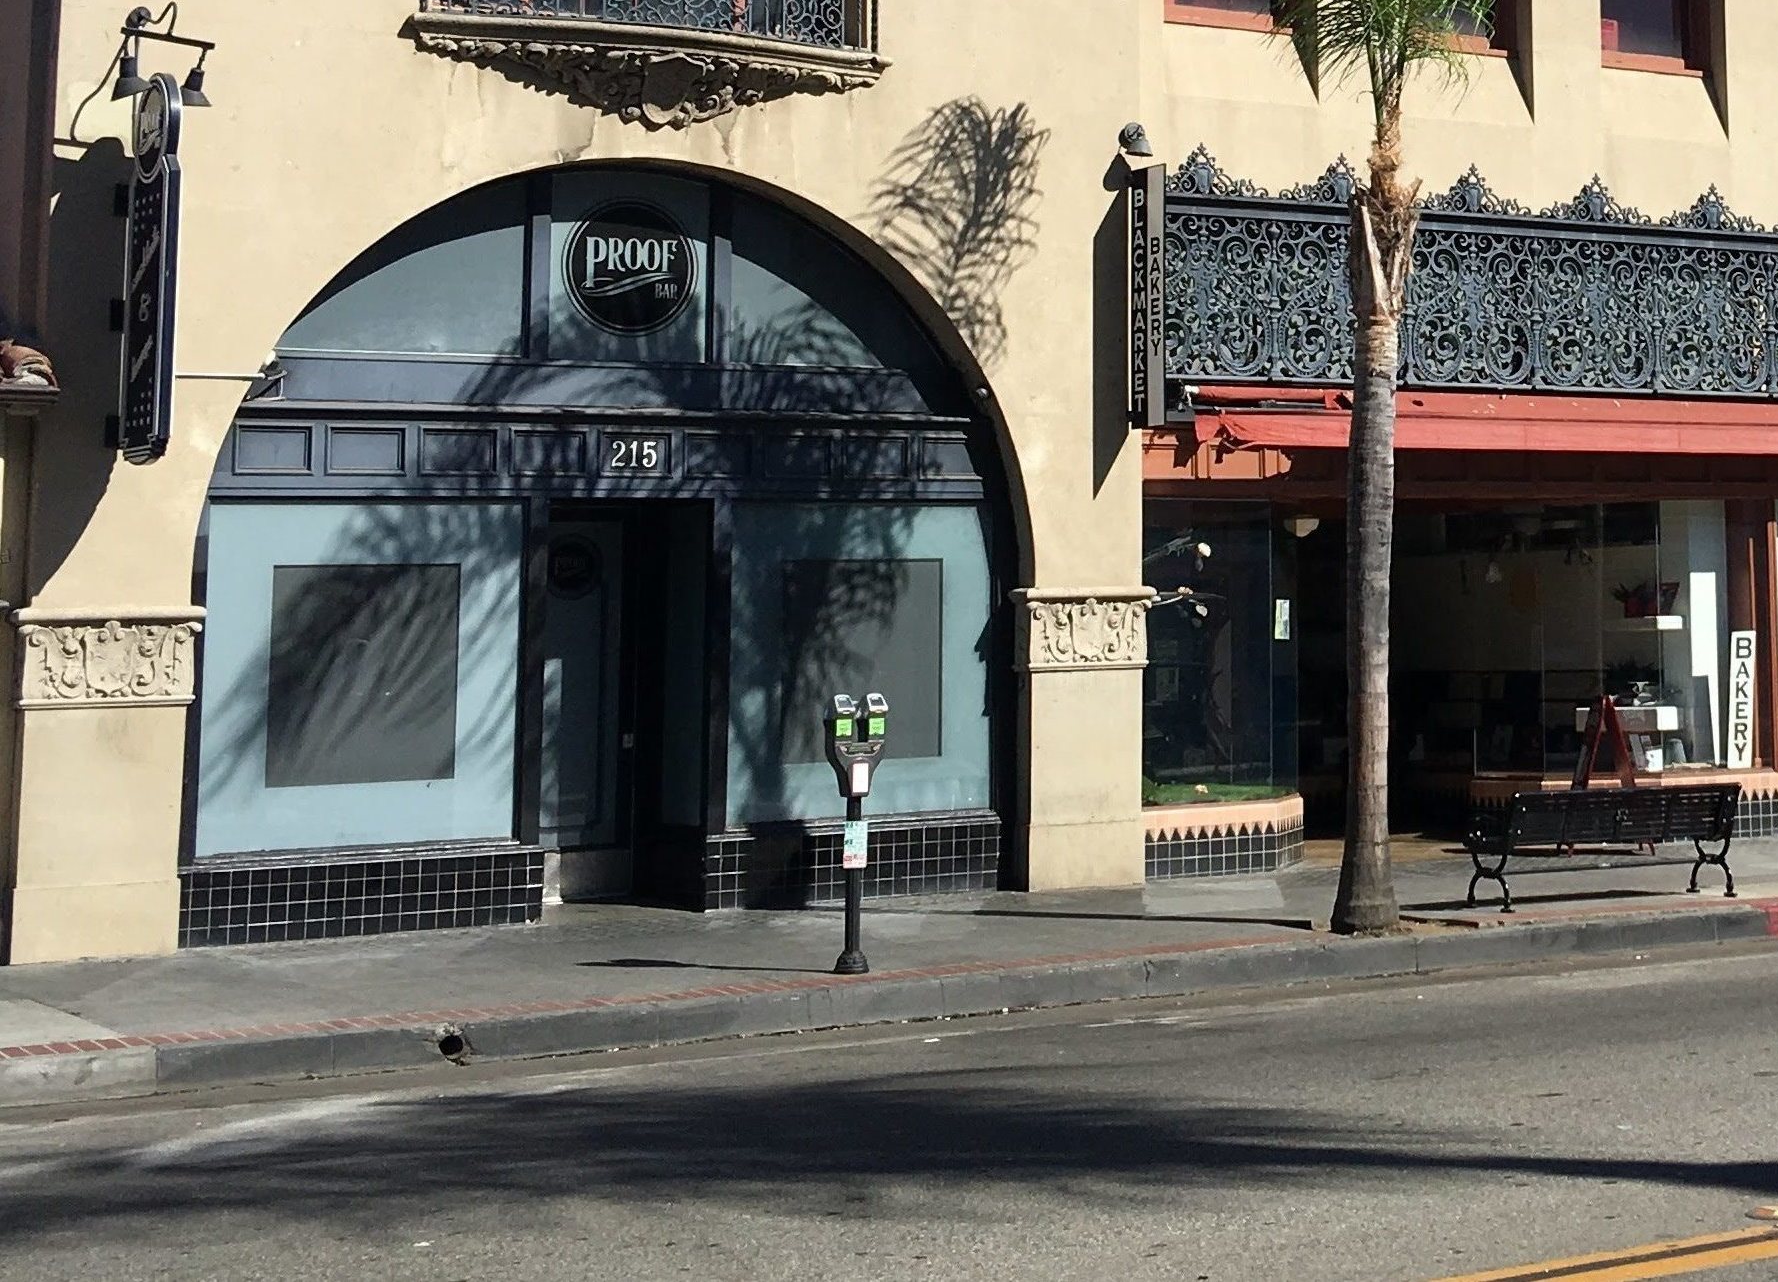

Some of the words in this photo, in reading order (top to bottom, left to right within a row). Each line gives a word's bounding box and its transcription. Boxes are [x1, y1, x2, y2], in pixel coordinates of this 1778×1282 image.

[582, 236, 679, 288] PROOF
[655, 283, 678, 299] BAR
[1132, 189, 1146, 412] BLACKMARKET
[1150, 237, 1161, 356] BAKERY
[611, 440, 658, 468] 215
[1734, 637, 1752, 761] BAKERY
